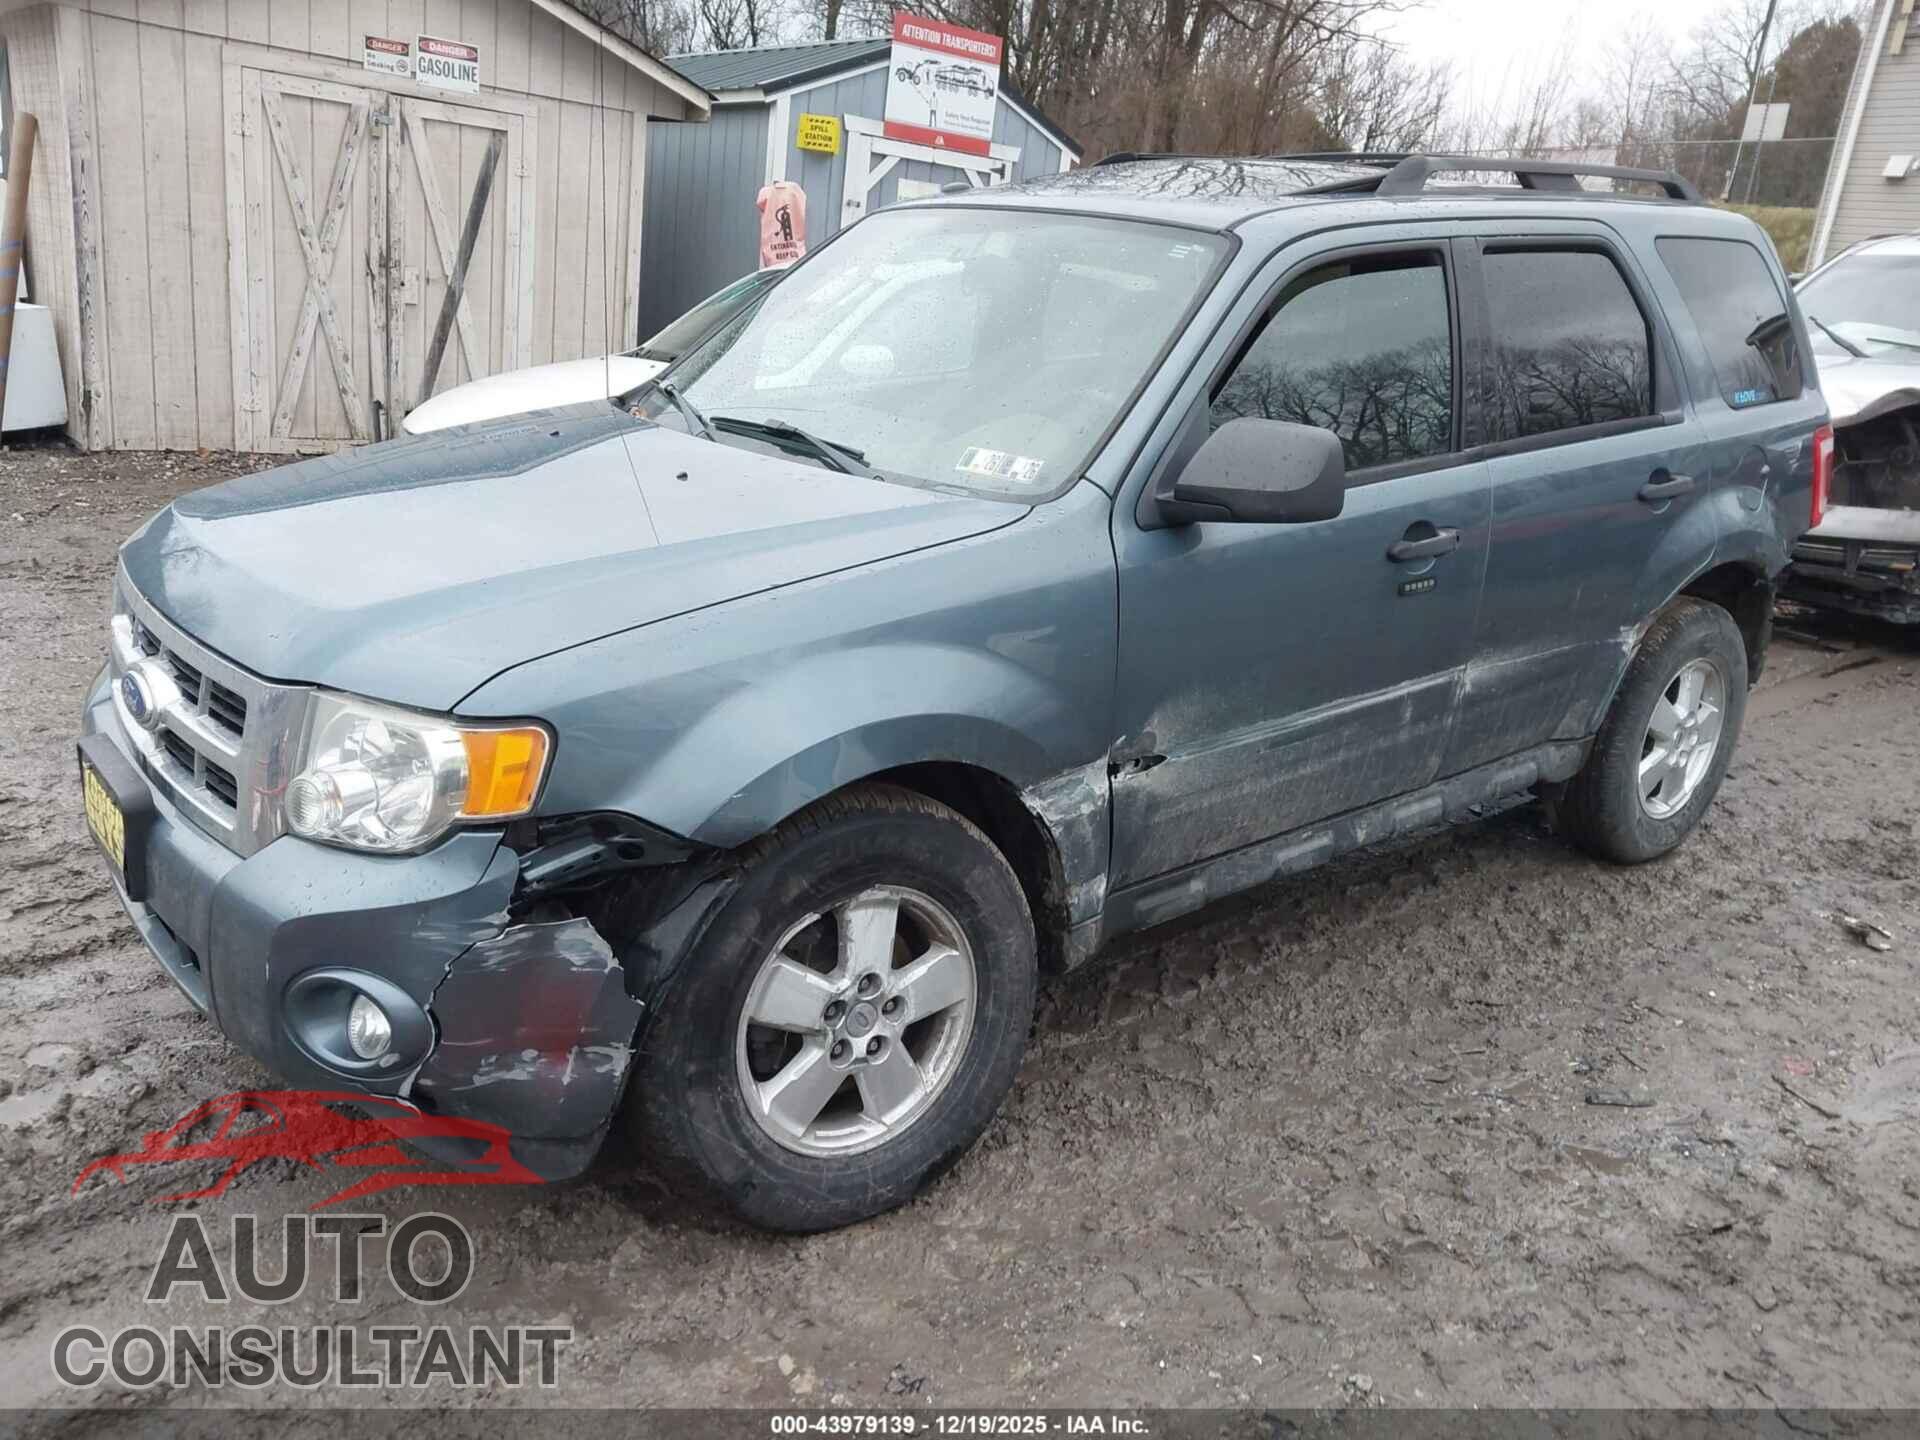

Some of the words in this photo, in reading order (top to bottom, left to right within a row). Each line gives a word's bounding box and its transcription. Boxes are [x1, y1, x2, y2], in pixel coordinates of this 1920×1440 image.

[372, 40, 402, 53] DANGER
[902, 24, 941, 44] ATTENTION
[942, 33, 996, 57] TRANSPORTERS!
[429, 41, 467, 57] DANGER
[367, 59, 394, 72] Smoking
[418, 56, 478, 83] GASOLINE
[810, 124, 828, 133] SPILL
[805, 132, 833, 142] STATION
